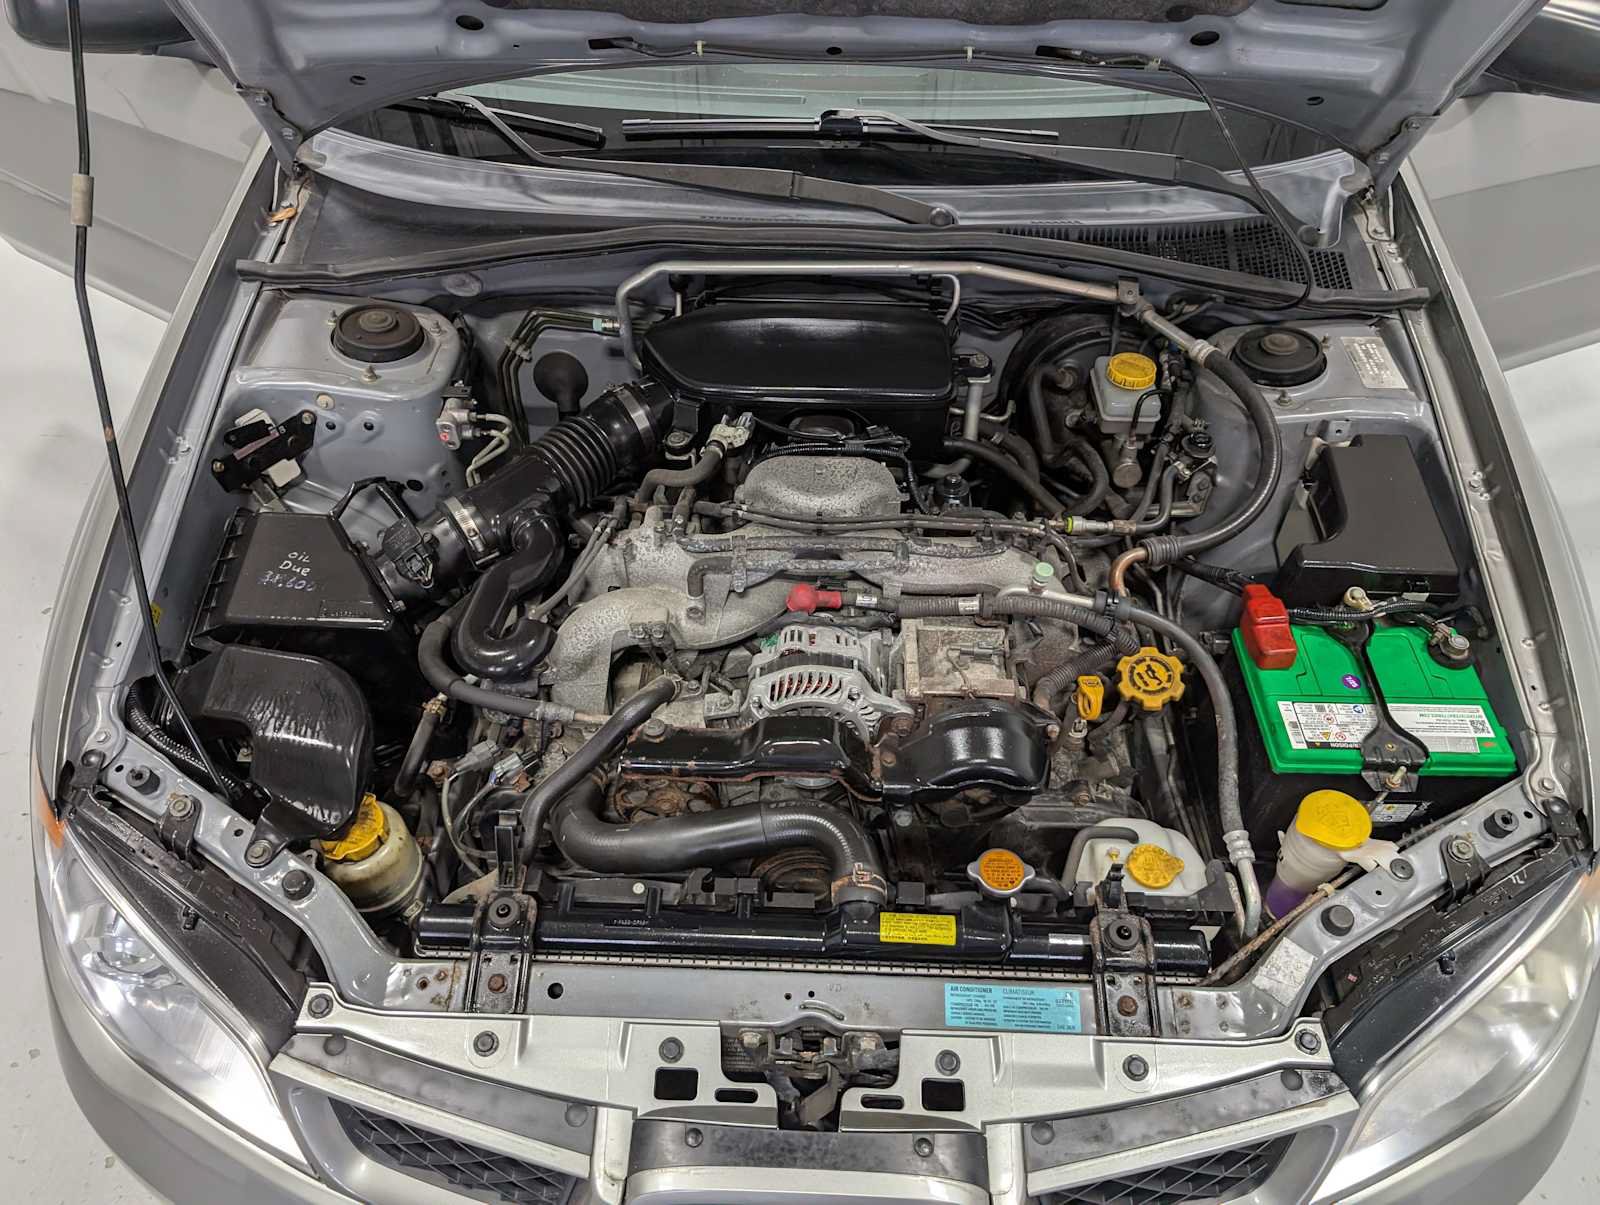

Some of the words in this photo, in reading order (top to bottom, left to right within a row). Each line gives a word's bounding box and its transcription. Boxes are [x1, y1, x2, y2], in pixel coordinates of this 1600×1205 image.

[279, 560, 311, 577] Due
[950, 985, 960, 993] AIR
[959, 985, 993, 995] CONDITIONER
